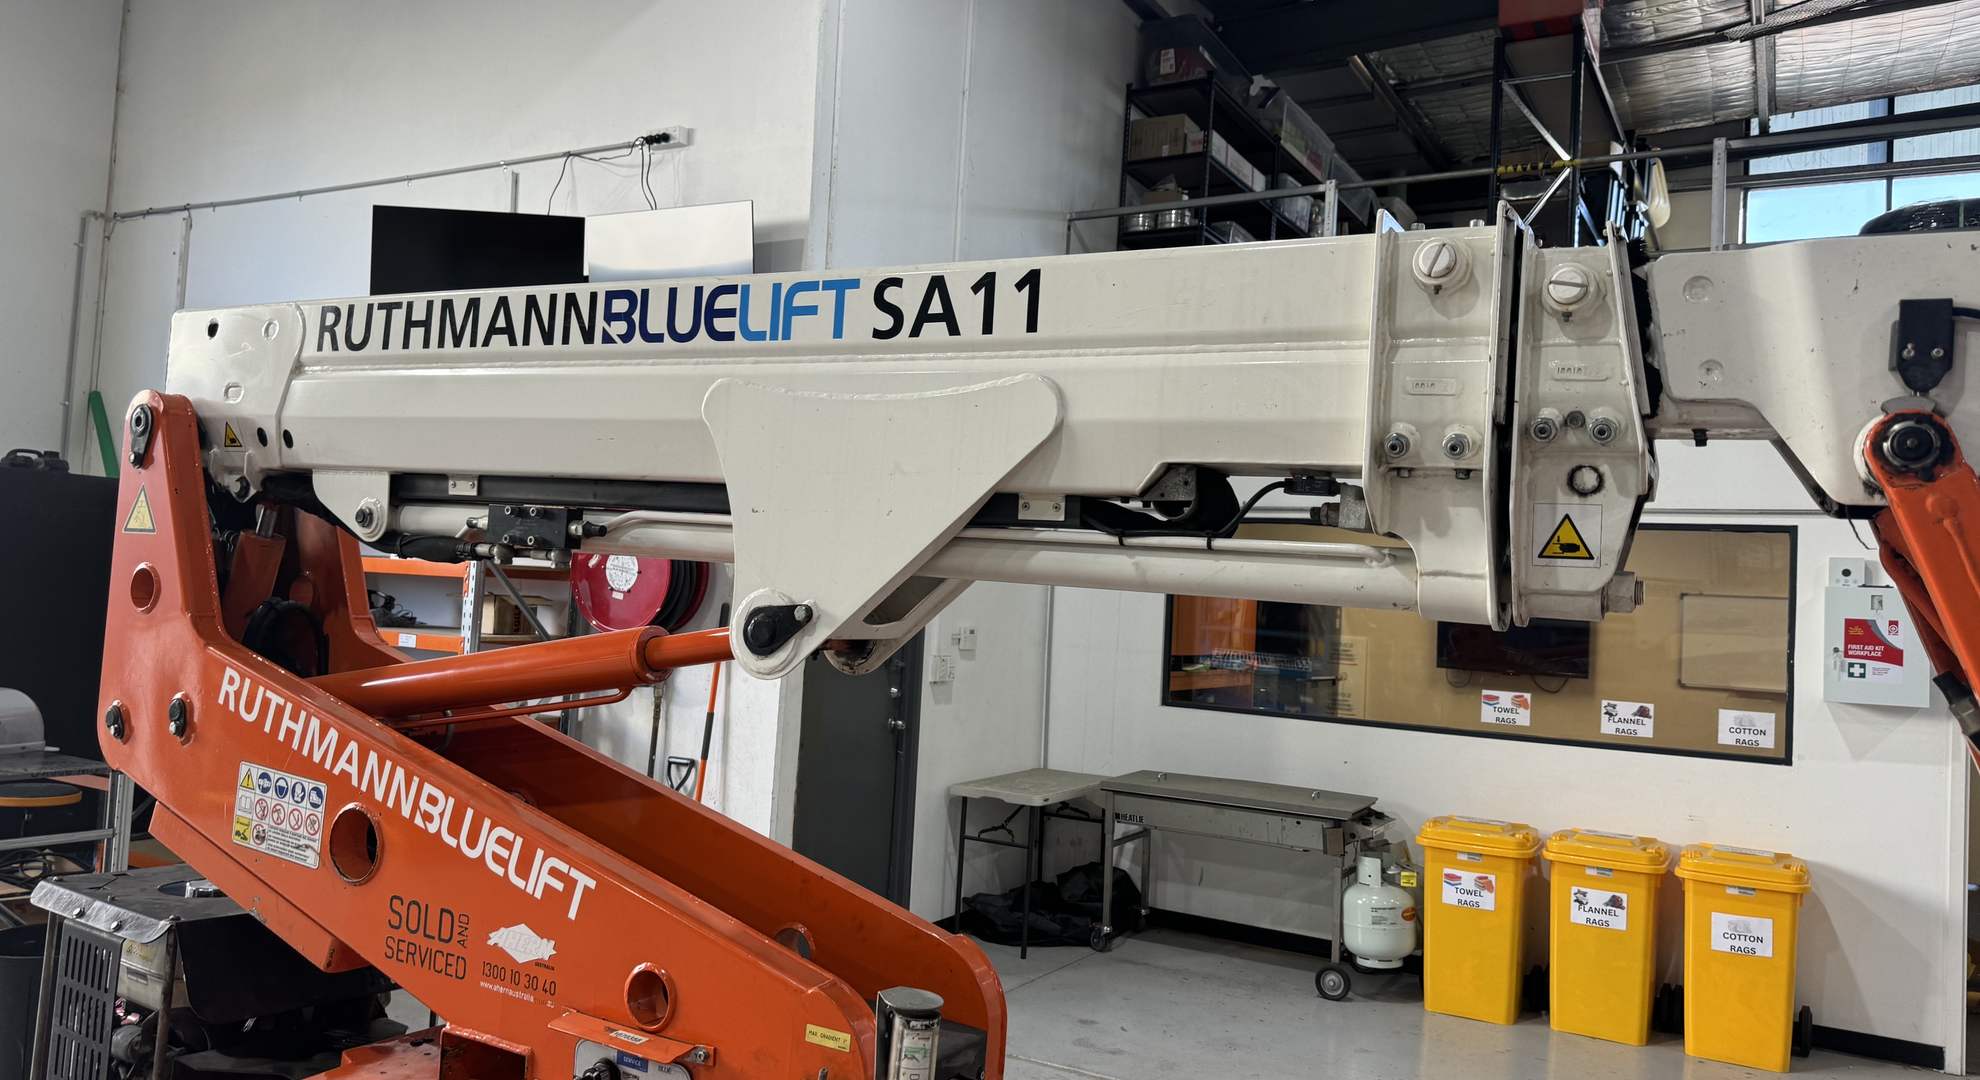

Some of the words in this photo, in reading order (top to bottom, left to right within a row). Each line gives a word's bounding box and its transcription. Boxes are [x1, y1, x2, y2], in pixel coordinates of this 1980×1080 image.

[871, 269, 1042, 340] SA11
[1493, 706, 1520, 715] TOWEL
[1495, 717, 1517, 725] RAGS
[1607, 716, 1647, 726] FLANNEL
[1615, 728, 1638, 736] RAGS
[1728, 726, 1767, 737] COTTON
[1735, 737, 1760, 747] RAGS
[1454, 887, 1484, 898] TOWEL
[1457, 898, 1480, 908] RAGS
[1578, 905, 1619, 917] FLANNEL
[387, 894, 455, 944] SOLD
[1585, 917, 1610, 928] RAGS
[456, 913, 470, 949] AND
[1722, 932, 1764, 944] COTTON
[1729, 944, 1757, 955] RAGS
[384, 935, 467, 980] SERVICED
[481, 960, 506, 982] 1300
[509, 969, 521, 986] 10
[524, 973, 539, 992] 30
[542, 979, 557, 997] 40
